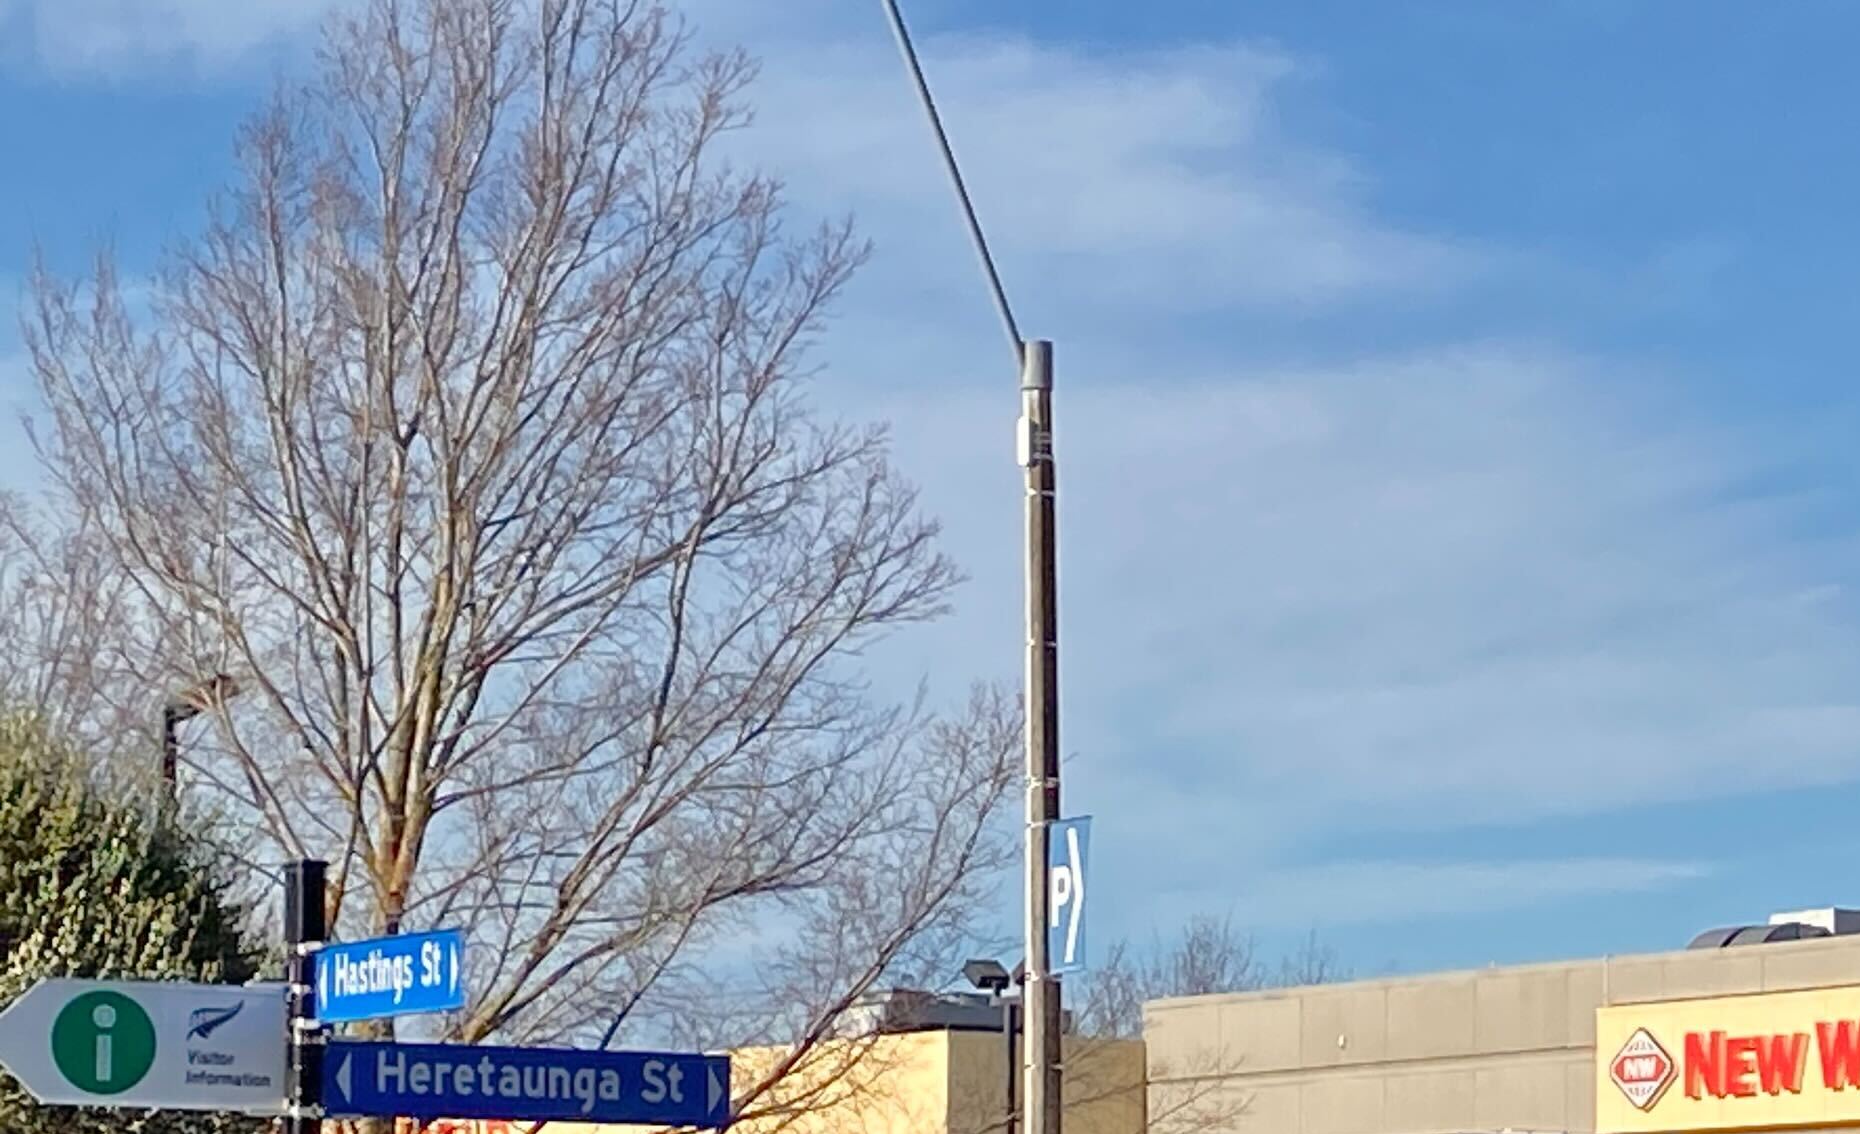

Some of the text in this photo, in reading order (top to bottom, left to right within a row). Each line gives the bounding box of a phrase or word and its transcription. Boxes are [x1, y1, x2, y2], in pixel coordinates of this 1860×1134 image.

[334, 940, 442, 1005] Hastings St
[376, 1050, 685, 1113] Heretaunga St
[1622, 1056, 1658, 1082] NW
[1684, 1030, 1809, 1100] NEW
